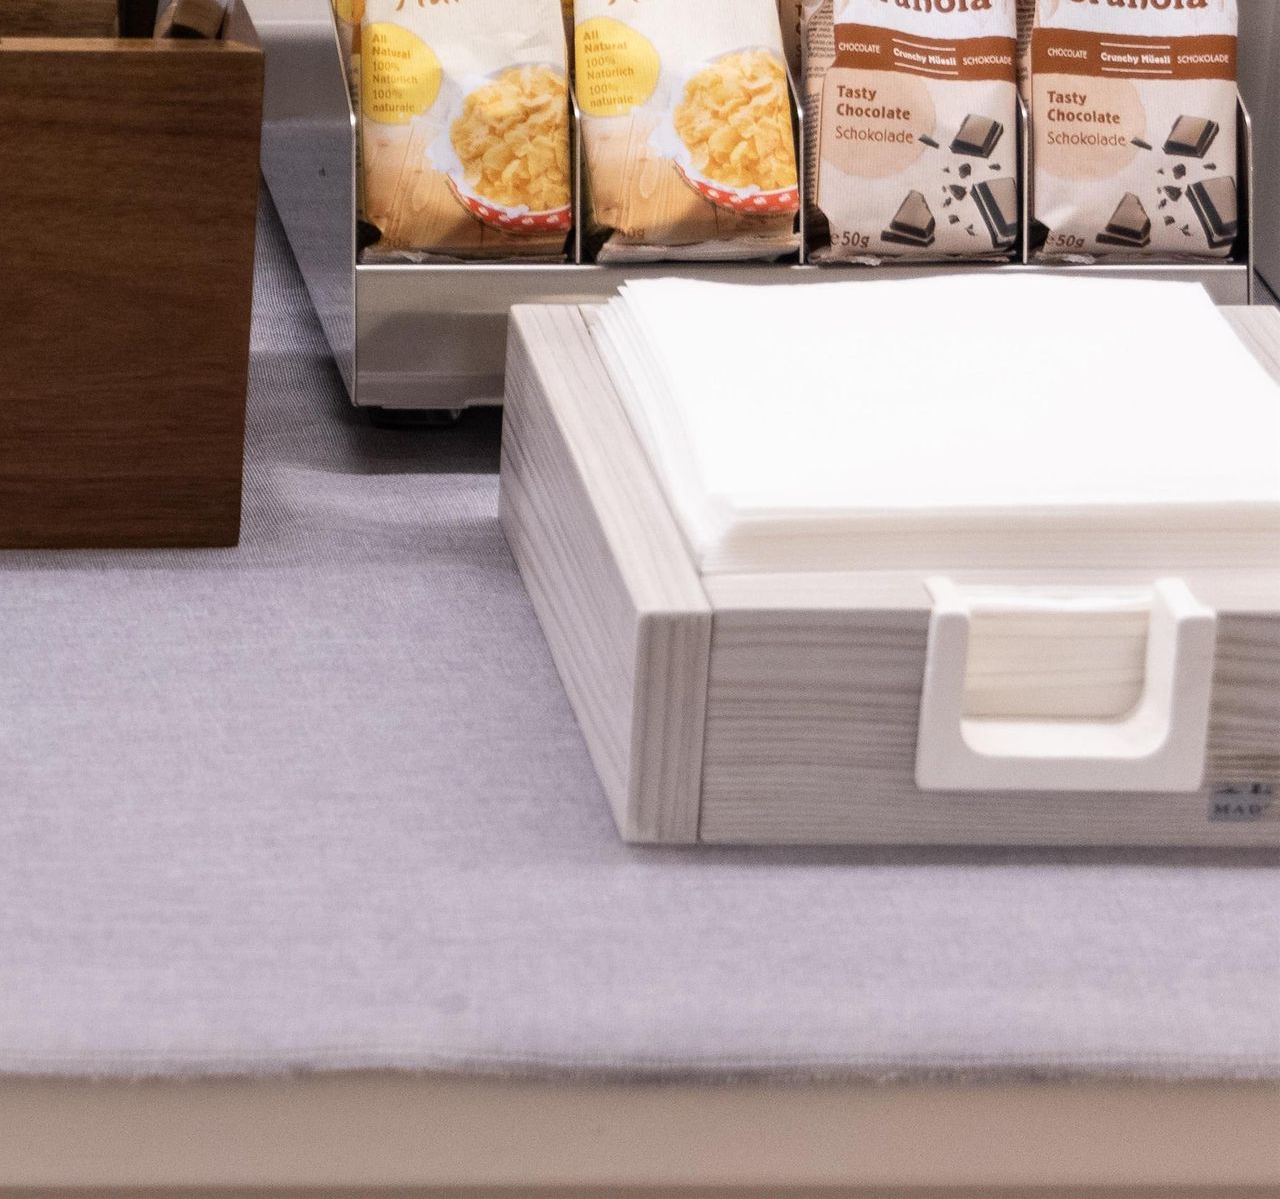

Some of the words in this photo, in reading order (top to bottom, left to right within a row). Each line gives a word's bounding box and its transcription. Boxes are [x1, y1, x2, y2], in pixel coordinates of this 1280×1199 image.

[372, 34, 387, 43] All
[584, 30, 599, 41] All
[372, 46, 411, 59] Natural
[584, 42, 628, 54] Natural
[838, 42, 881, 54] CHOCOLATE
[893, 47, 927, 64] Crunchy
[962, 55, 1013, 66] SCHOKOLADE
[586, 56, 617, 69] 100%
[1047, 47, 1088, 60] CHOCOLATE
[1100, 52, 1139, 65] Crunchy
[1177, 54, 1230, 64] SCHOKOLADE
[373, 61, 401, 72] 100%
[373, 89, 403, 99] 100%
[590, 84, 619, 96] 100%
[837, 85, 877, 101] Tasty
[1047, 91, 1087, 106] Tasty
[836, 103, 911, 121] Chocolate
[1047, 108, 1121, 125] Chocolate
[835, 126, 914, 144] Schokolade
[1047, 131, 1127, 147] Schokolade
